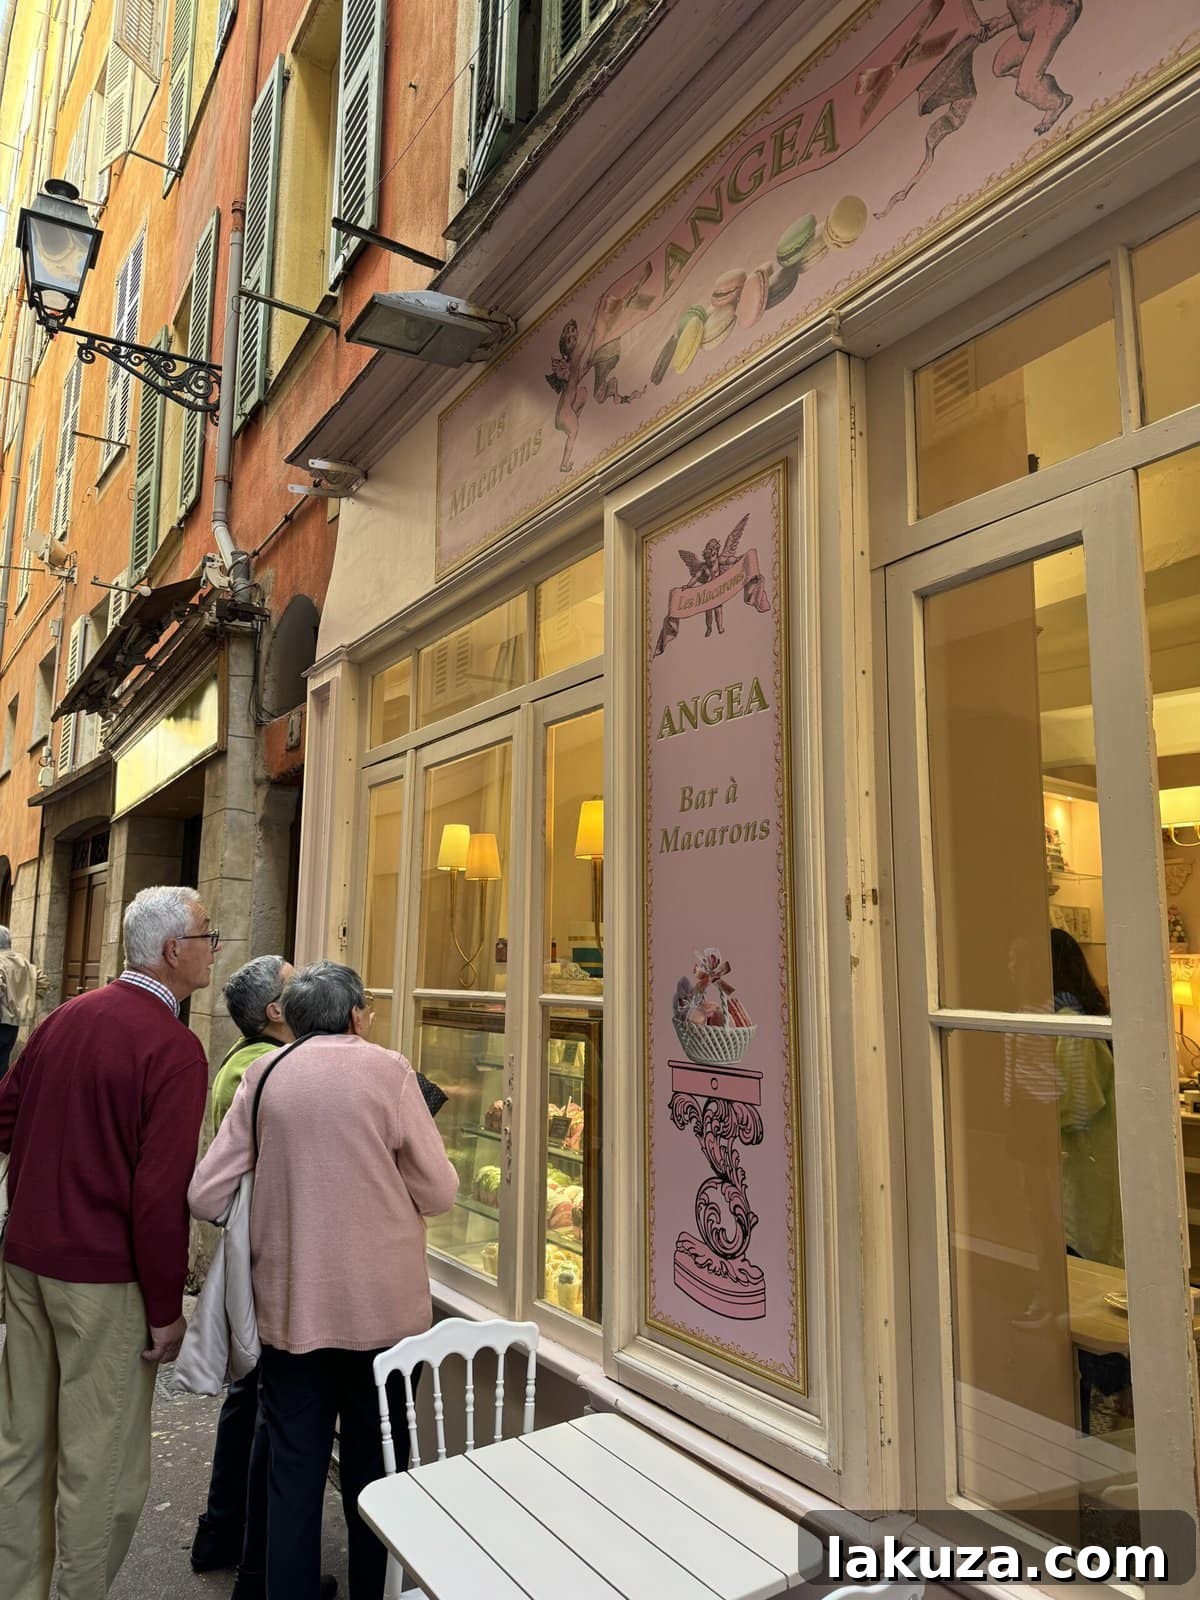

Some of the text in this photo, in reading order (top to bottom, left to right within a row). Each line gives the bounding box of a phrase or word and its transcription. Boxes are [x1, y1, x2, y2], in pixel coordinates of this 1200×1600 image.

[664, 100, 839, 295] ANGEA
[474, 411, 506, 456] Les
[450, 428, 542, 520] Macarons
[678, 573, 744, 611] Les Macarons
[657, 677, 770, 741] ANGEA
[679, 775, 739, 813] Bar à
[659, 818, 770, 854] Macarons
